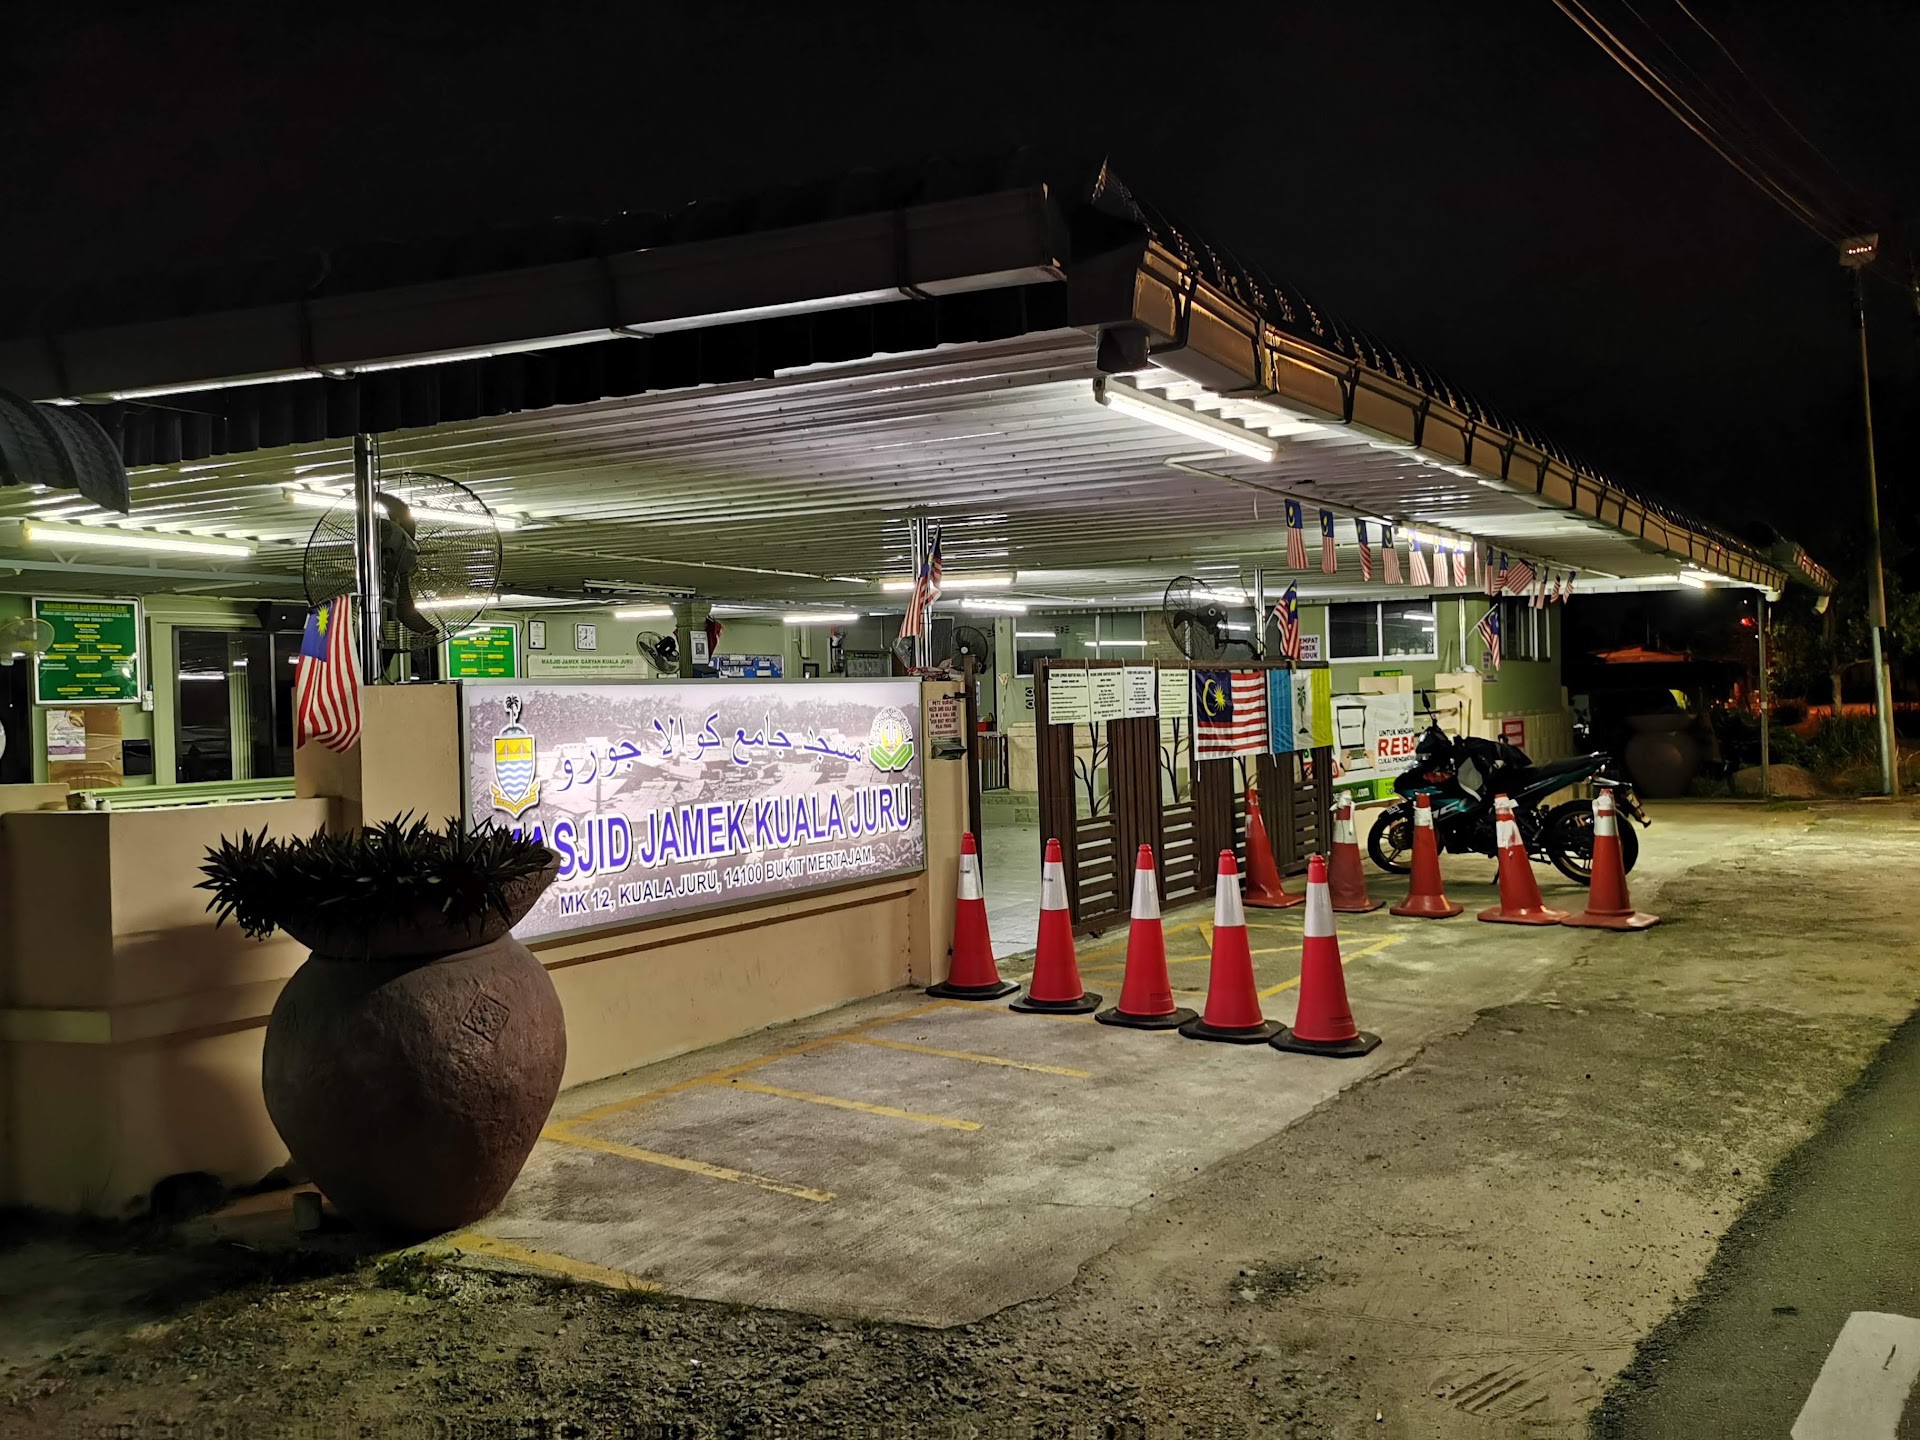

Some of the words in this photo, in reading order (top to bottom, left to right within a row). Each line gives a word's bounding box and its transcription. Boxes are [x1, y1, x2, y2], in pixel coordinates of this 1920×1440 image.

[733, 712, 791, 766] جامع
[804, 727, 861, 763] مسجد
[512, 817, 630, 876] SJID
[641, 803, 747, 863] JAMEK
[755, 794, 844, 846] KUALA
[850, 785, 910, 832] JURU
[560, 893, 587, 915] MK
[593, 889, 616, 911] 12,
[620, 879, 674, 904] KUALA
[678, 870, 722, 896] JURU,
[725, 865, 762, 888] 14100
[767, 859, 804, 880] BUKIT
[807, 847, 875, 872] MERTAJAM.
